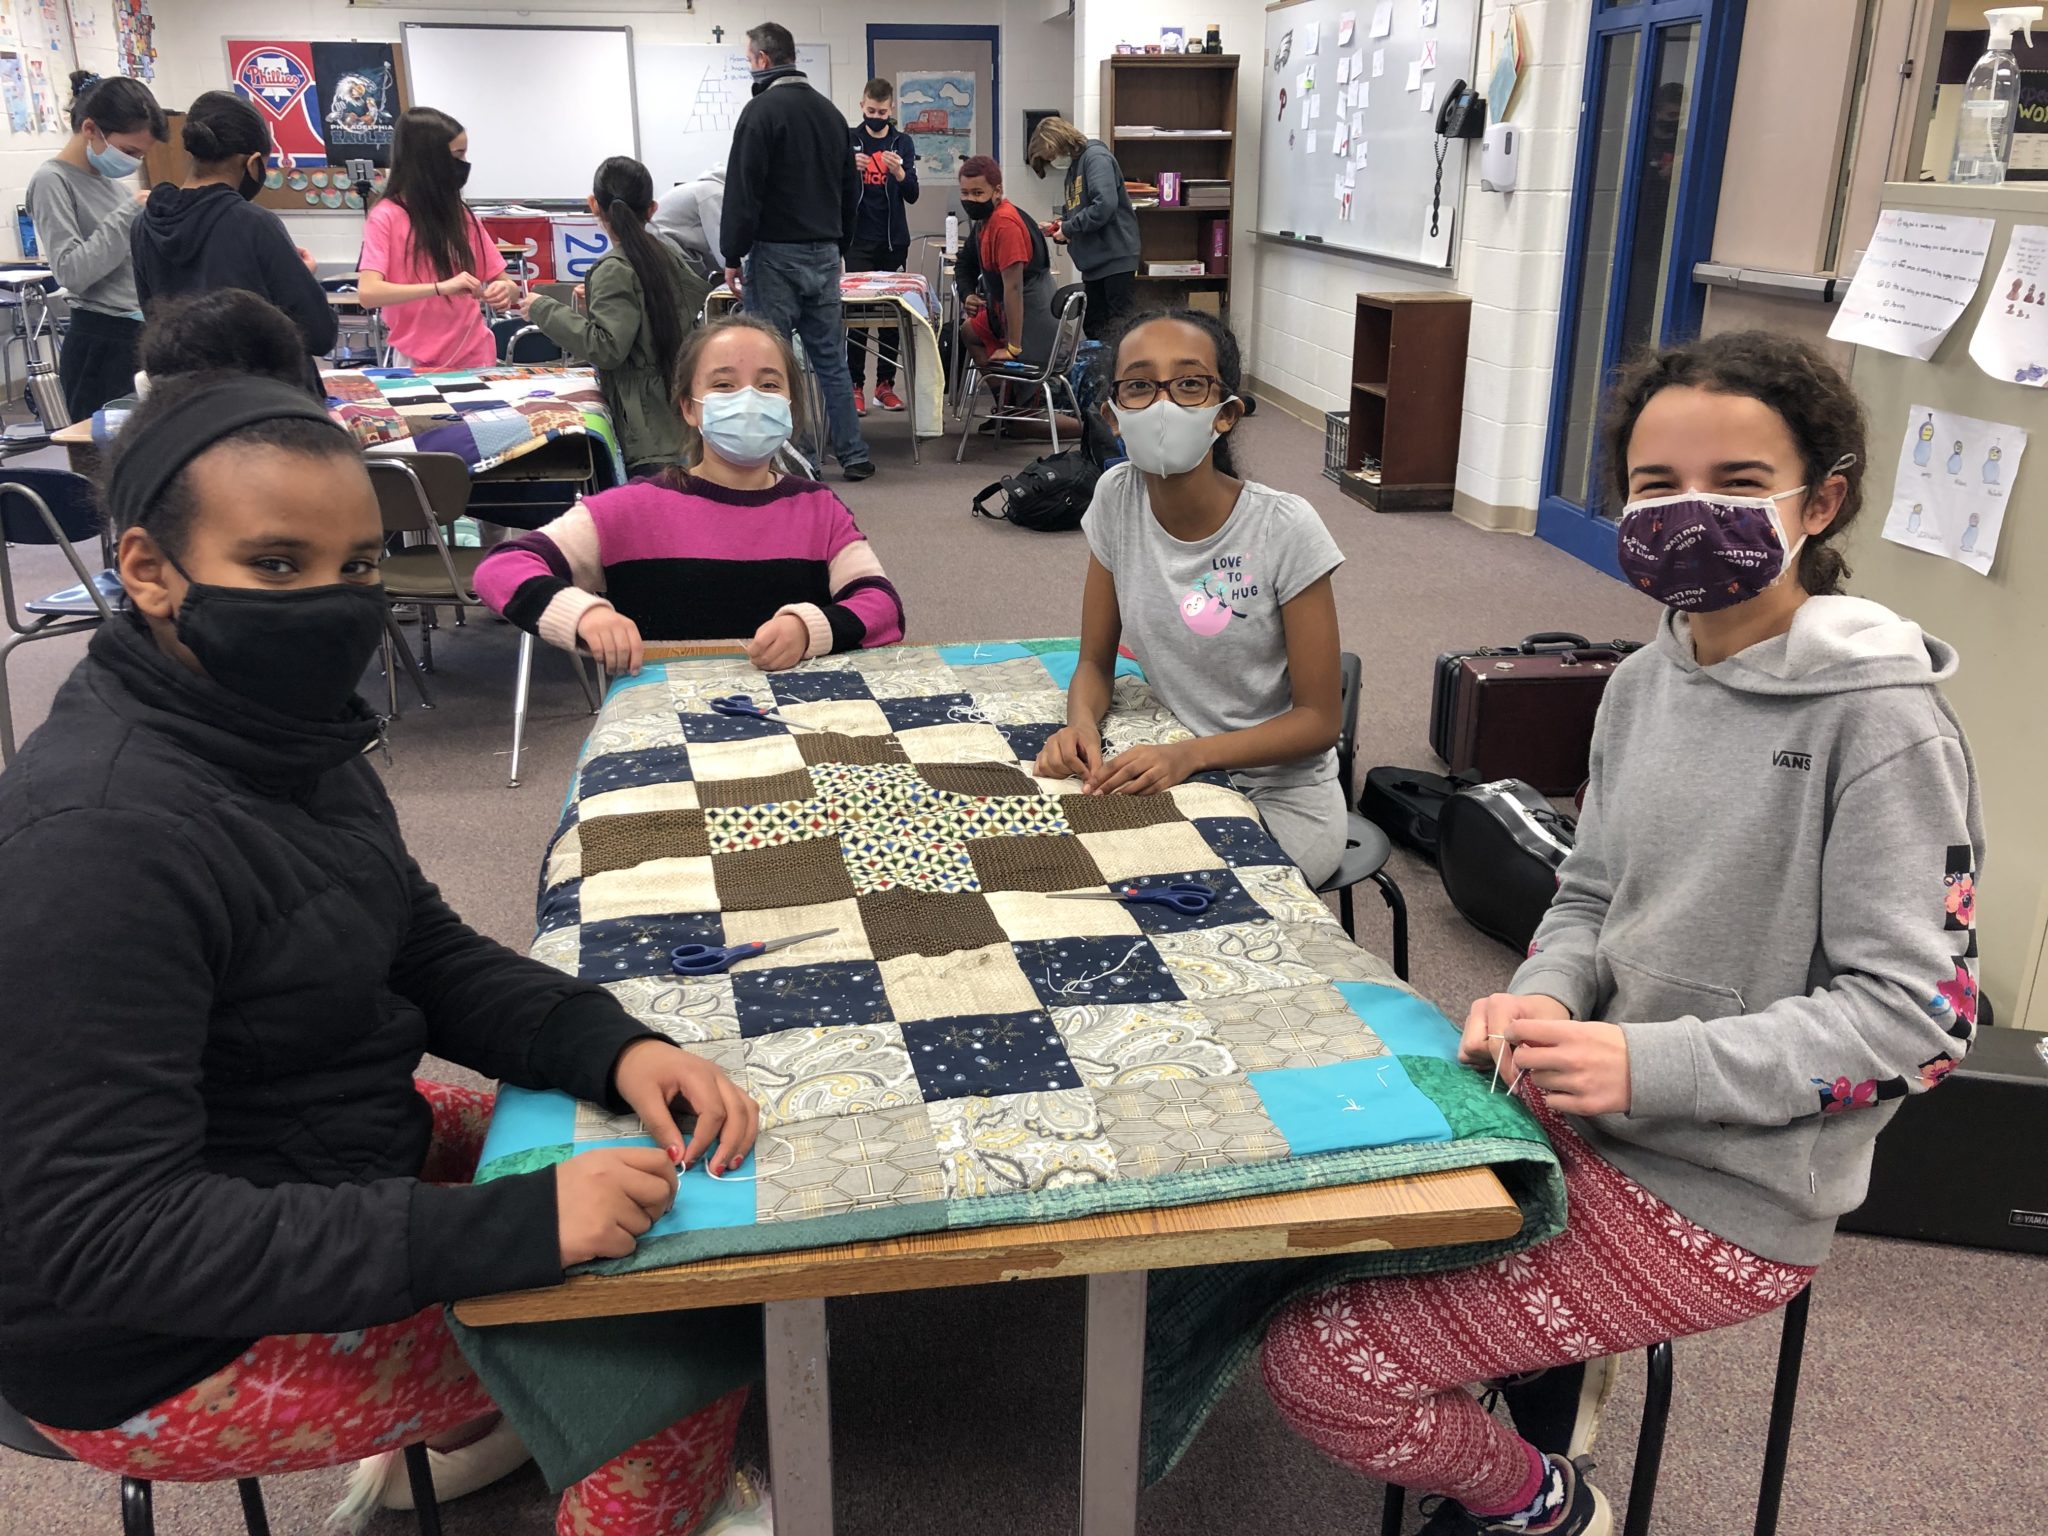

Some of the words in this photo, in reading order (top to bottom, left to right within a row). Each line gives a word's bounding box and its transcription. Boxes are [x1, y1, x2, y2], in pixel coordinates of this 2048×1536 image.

[247, 65, 300, 88] Phillies
[331, 130, 394, 144] EAGLES
[1682, 524, 1707, 536] You
[1745, 550, 1769, 560] You
[1212, 556, 1242, 570] LOVE
[1227, 572, 1242, 583] TO
[1231, 585, 1258, 600] HUG
[1684, 587, 1707, 596] You
[1772, 750, 1813, 771] VANS
